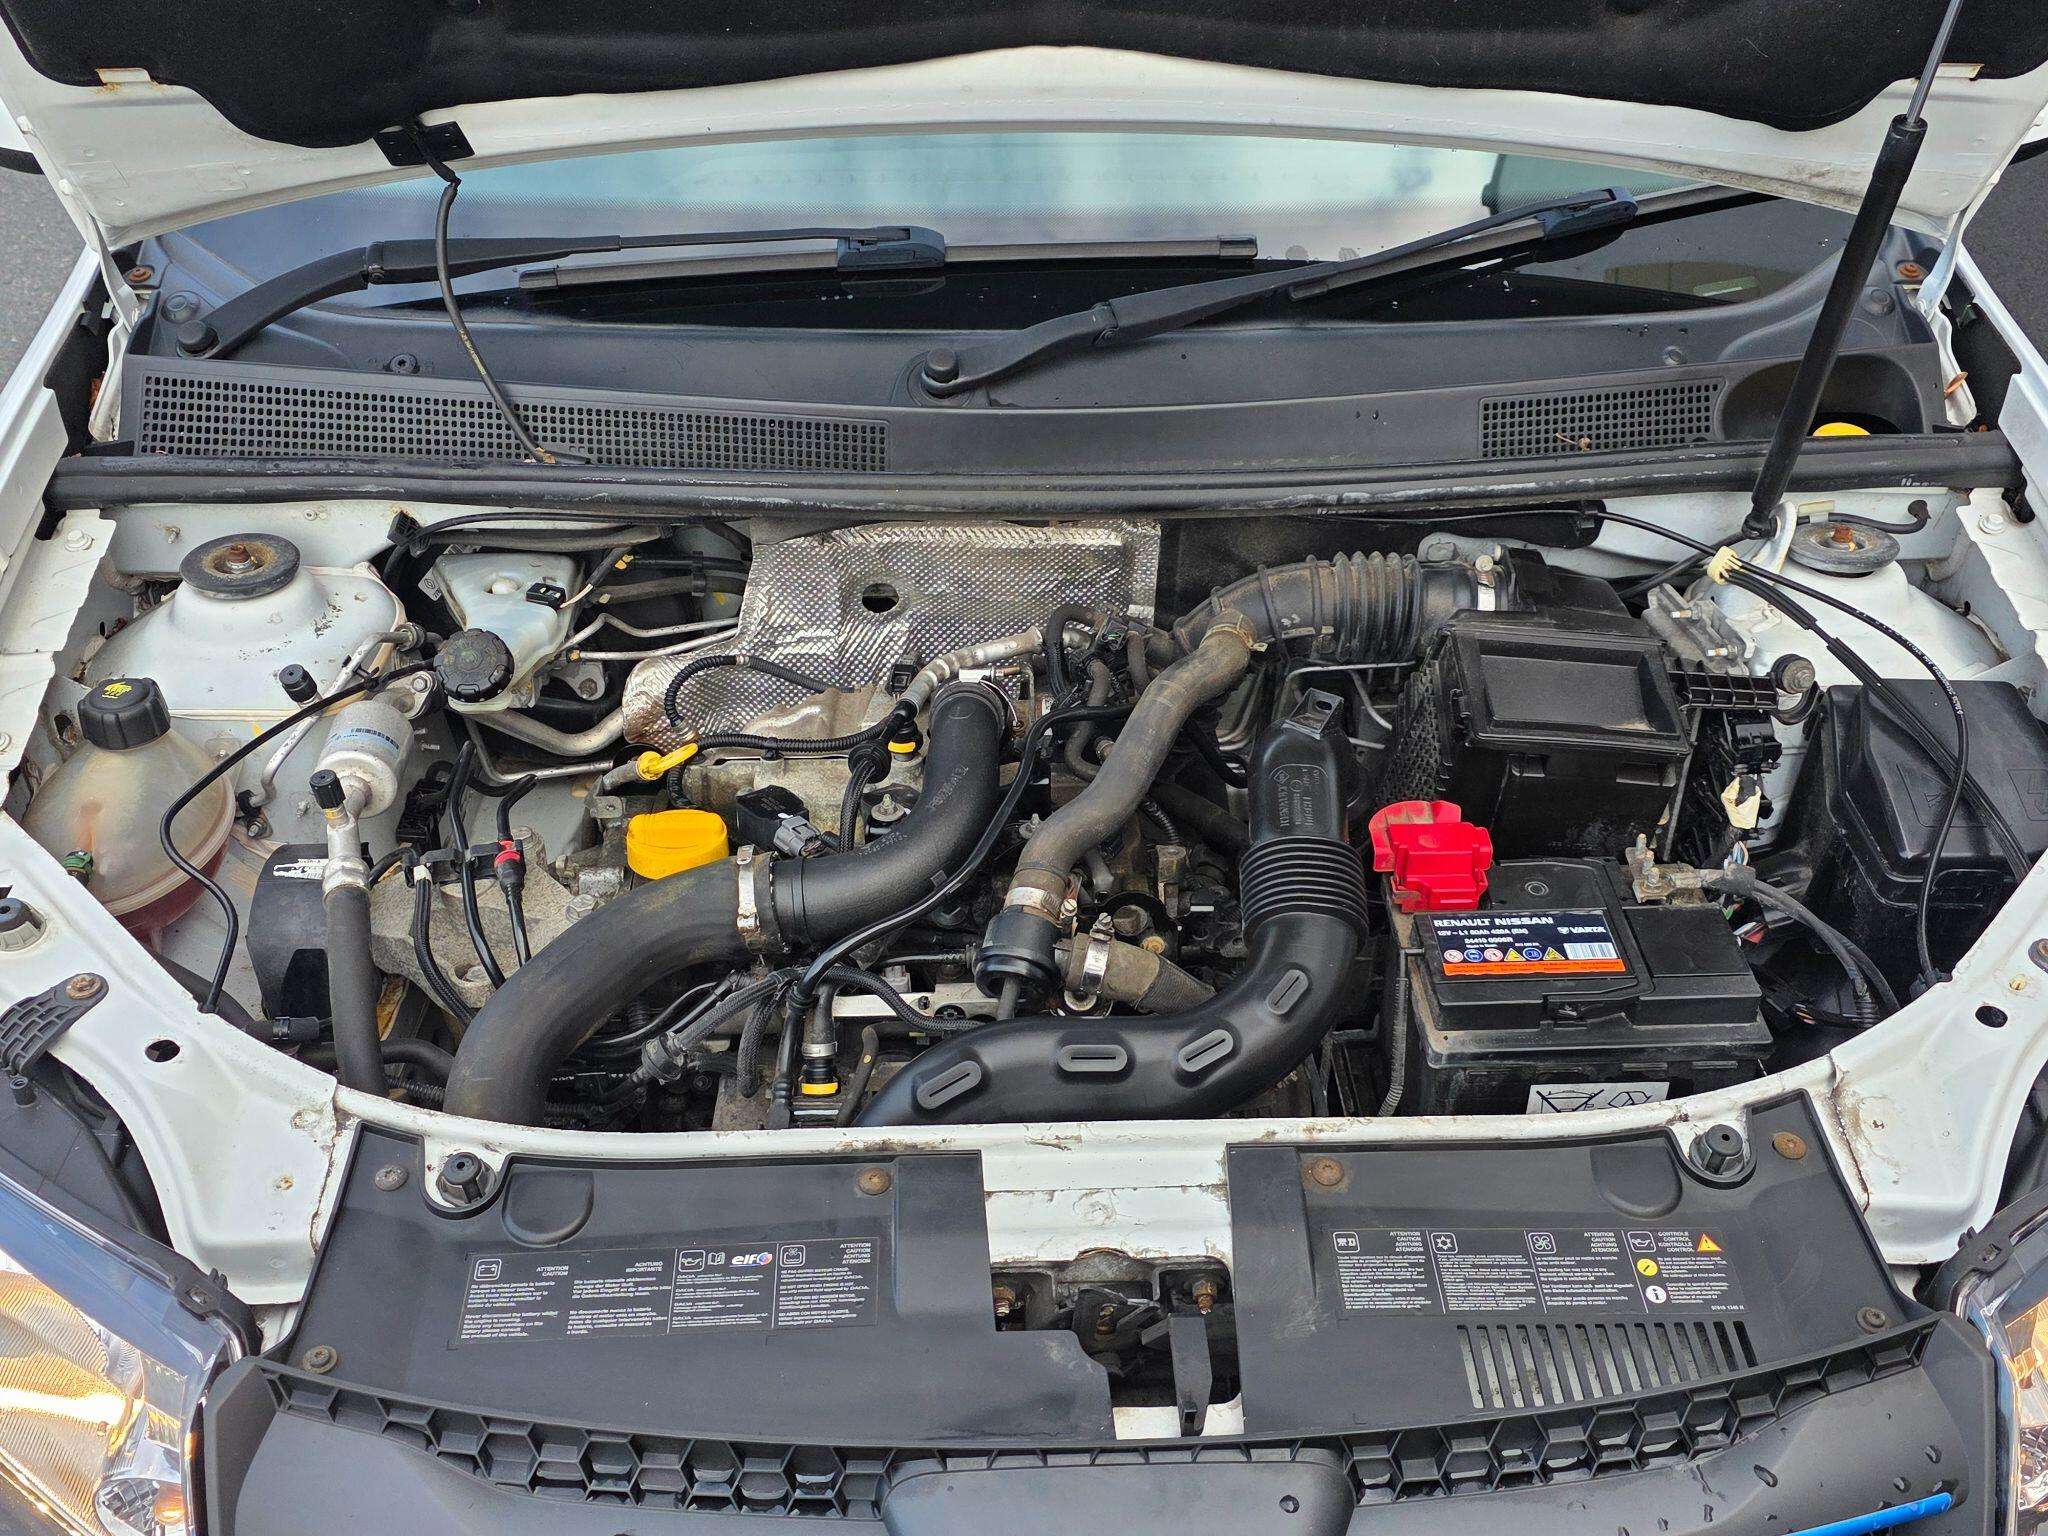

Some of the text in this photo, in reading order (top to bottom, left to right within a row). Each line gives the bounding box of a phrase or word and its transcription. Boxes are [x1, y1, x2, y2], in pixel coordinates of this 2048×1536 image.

[1433, 917, 1554, 927] RENAULT NISSAN
[1569, 926, 1606, 934] VARTA
